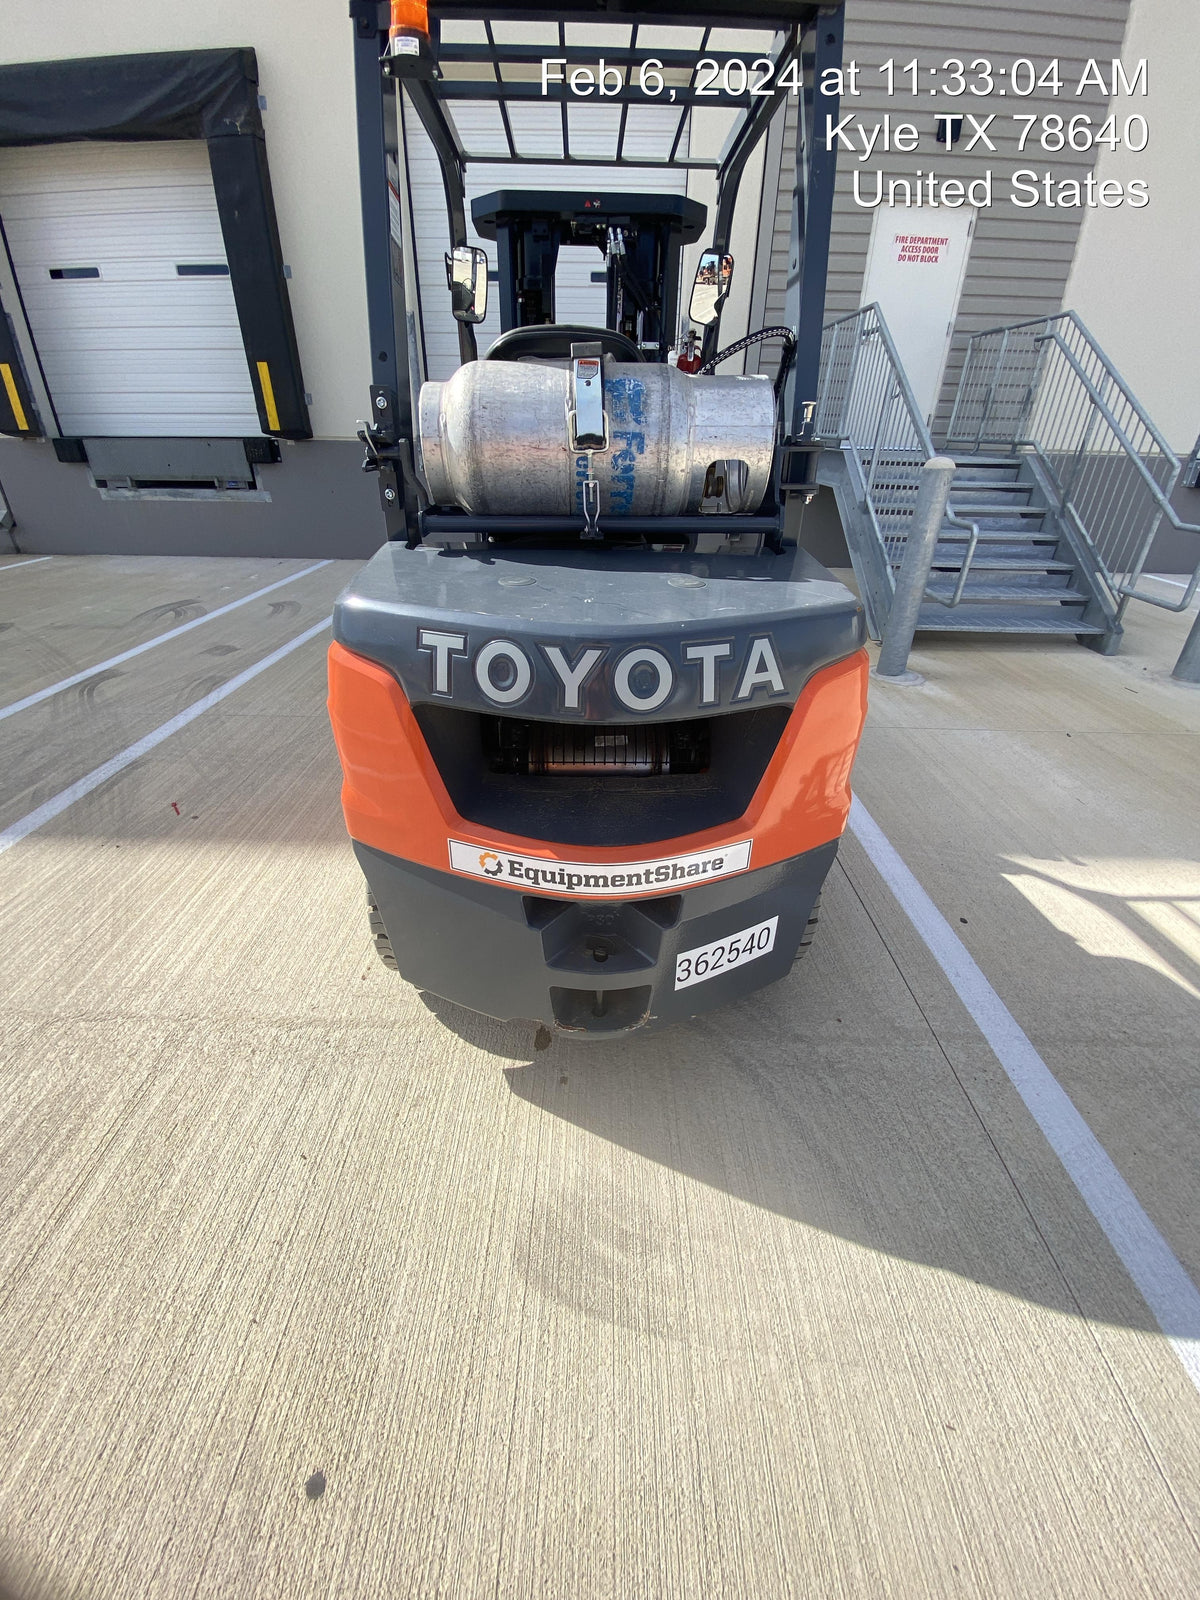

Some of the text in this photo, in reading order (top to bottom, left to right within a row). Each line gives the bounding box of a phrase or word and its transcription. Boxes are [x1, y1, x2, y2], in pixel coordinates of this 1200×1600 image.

[895, 235, 949, 246] FIRE DEPARTMENT
[900, 245, 939, 255] ACCESS DOOR
[897, 254, 939, 263] DO NOT BLOCK
[419, 630, 787, 712] TOYOTA
[507, 854, 725, 891] EquipmentShare
[676, 926, 772, 984] 362540
